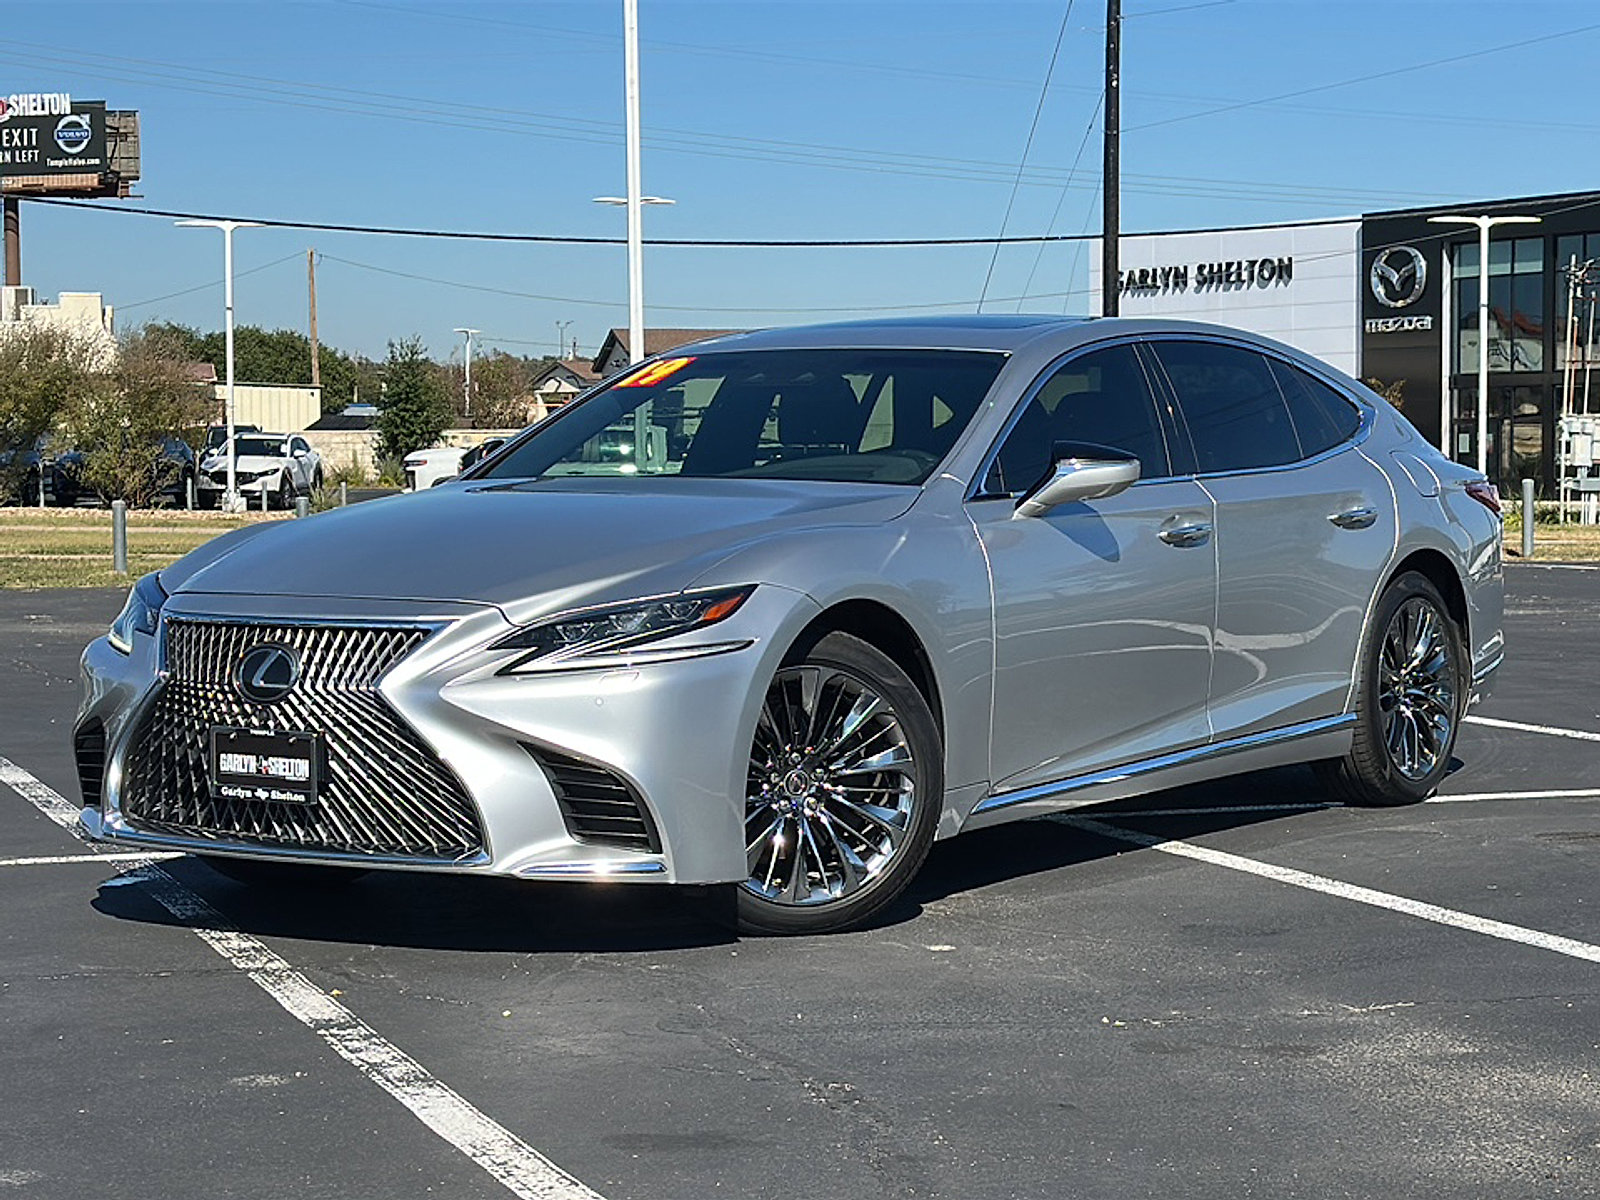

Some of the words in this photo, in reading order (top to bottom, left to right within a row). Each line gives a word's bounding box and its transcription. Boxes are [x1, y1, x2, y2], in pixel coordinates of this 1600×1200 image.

[9, 93, 71, 116] SHELTON
[2, 128, 38, 147] EXIT
[58, 131, 88, 139] VOLVO
[15, 150, 39, 162] LEFT
[1195, 256, 1293, 284] SHELTON
[220, 753, 257, 773] GARLYN
[267, 756, 310, 778] SHELTON
